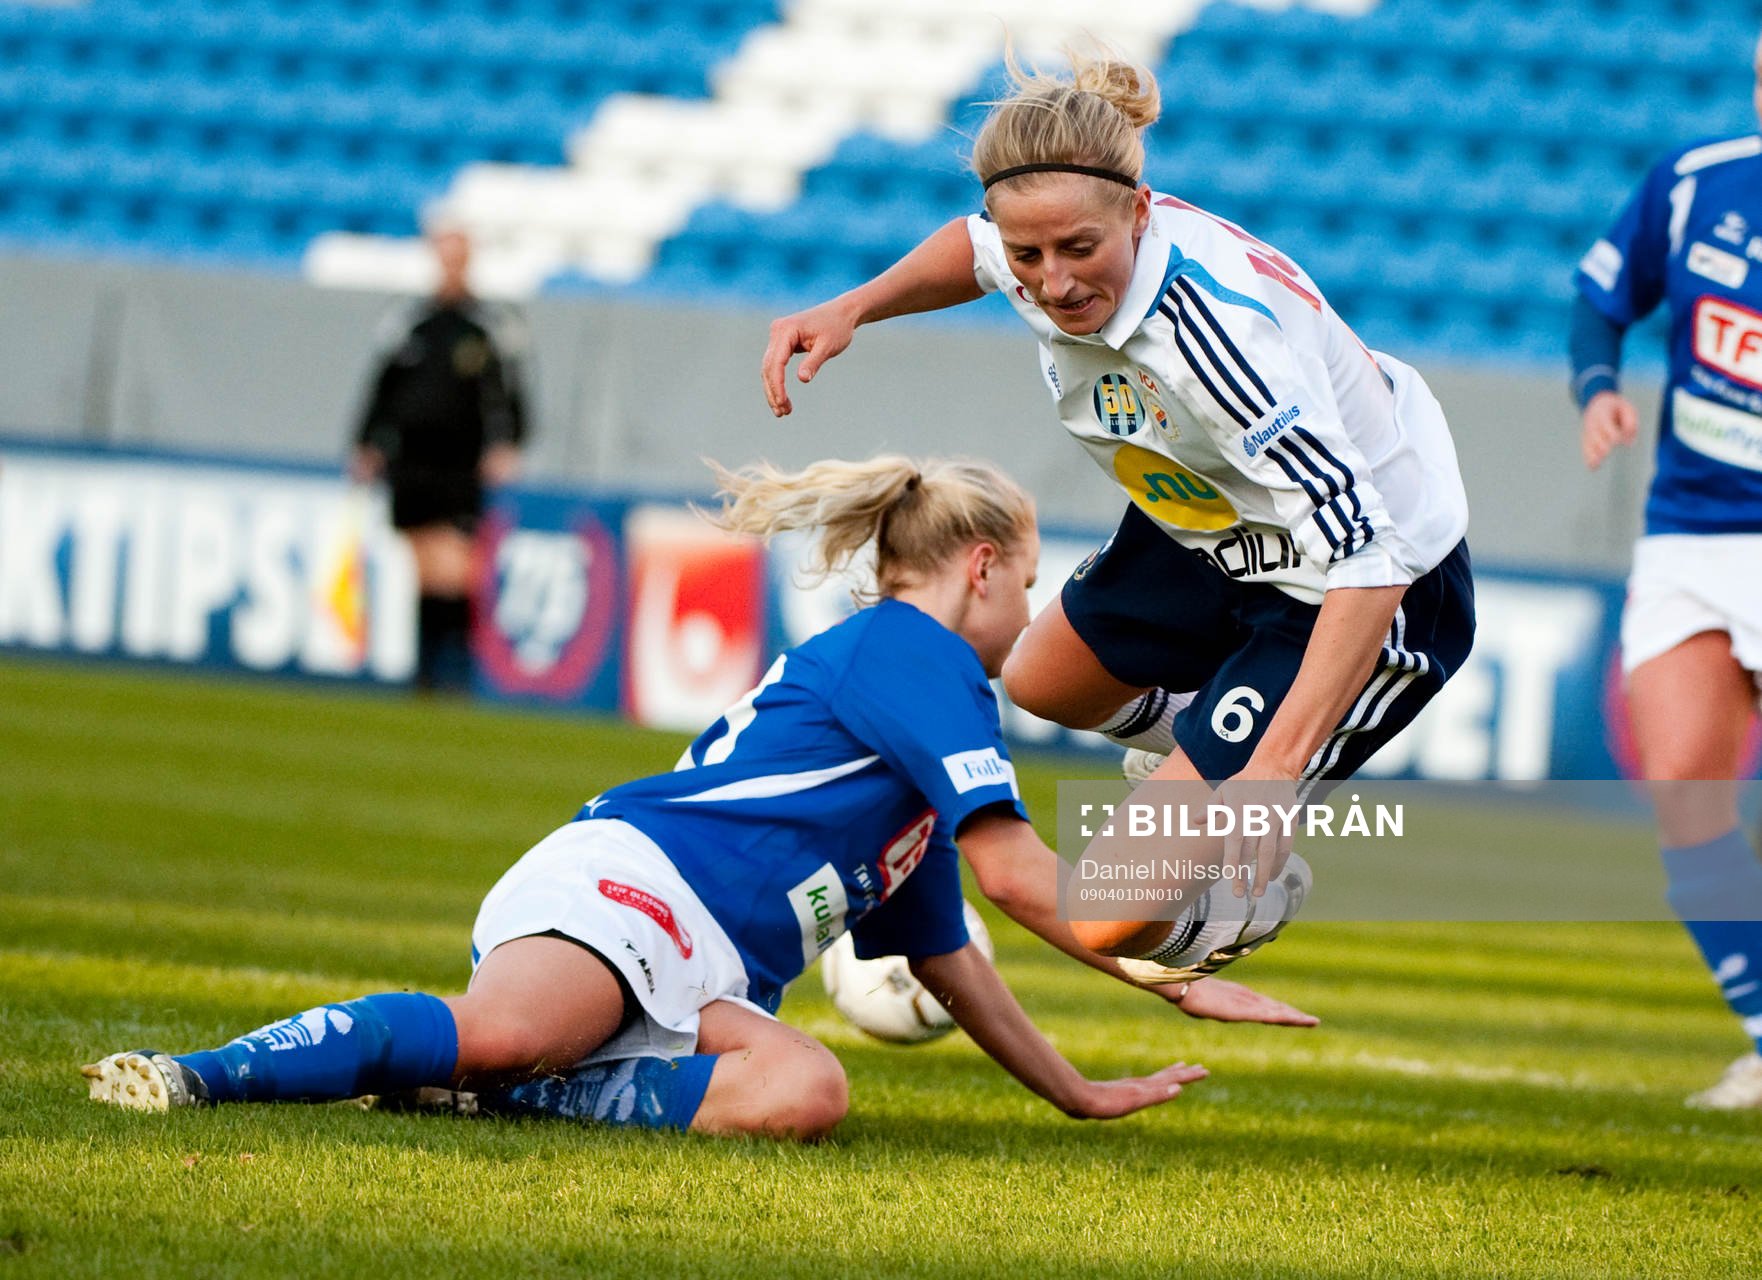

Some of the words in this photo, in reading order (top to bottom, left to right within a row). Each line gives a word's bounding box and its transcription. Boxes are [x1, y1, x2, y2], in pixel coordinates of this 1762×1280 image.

[1101, 383, 1137, 415] 50
[1251, 405, 1301, 449] Nautilus
[1211, 685, 1265, 743] 6
